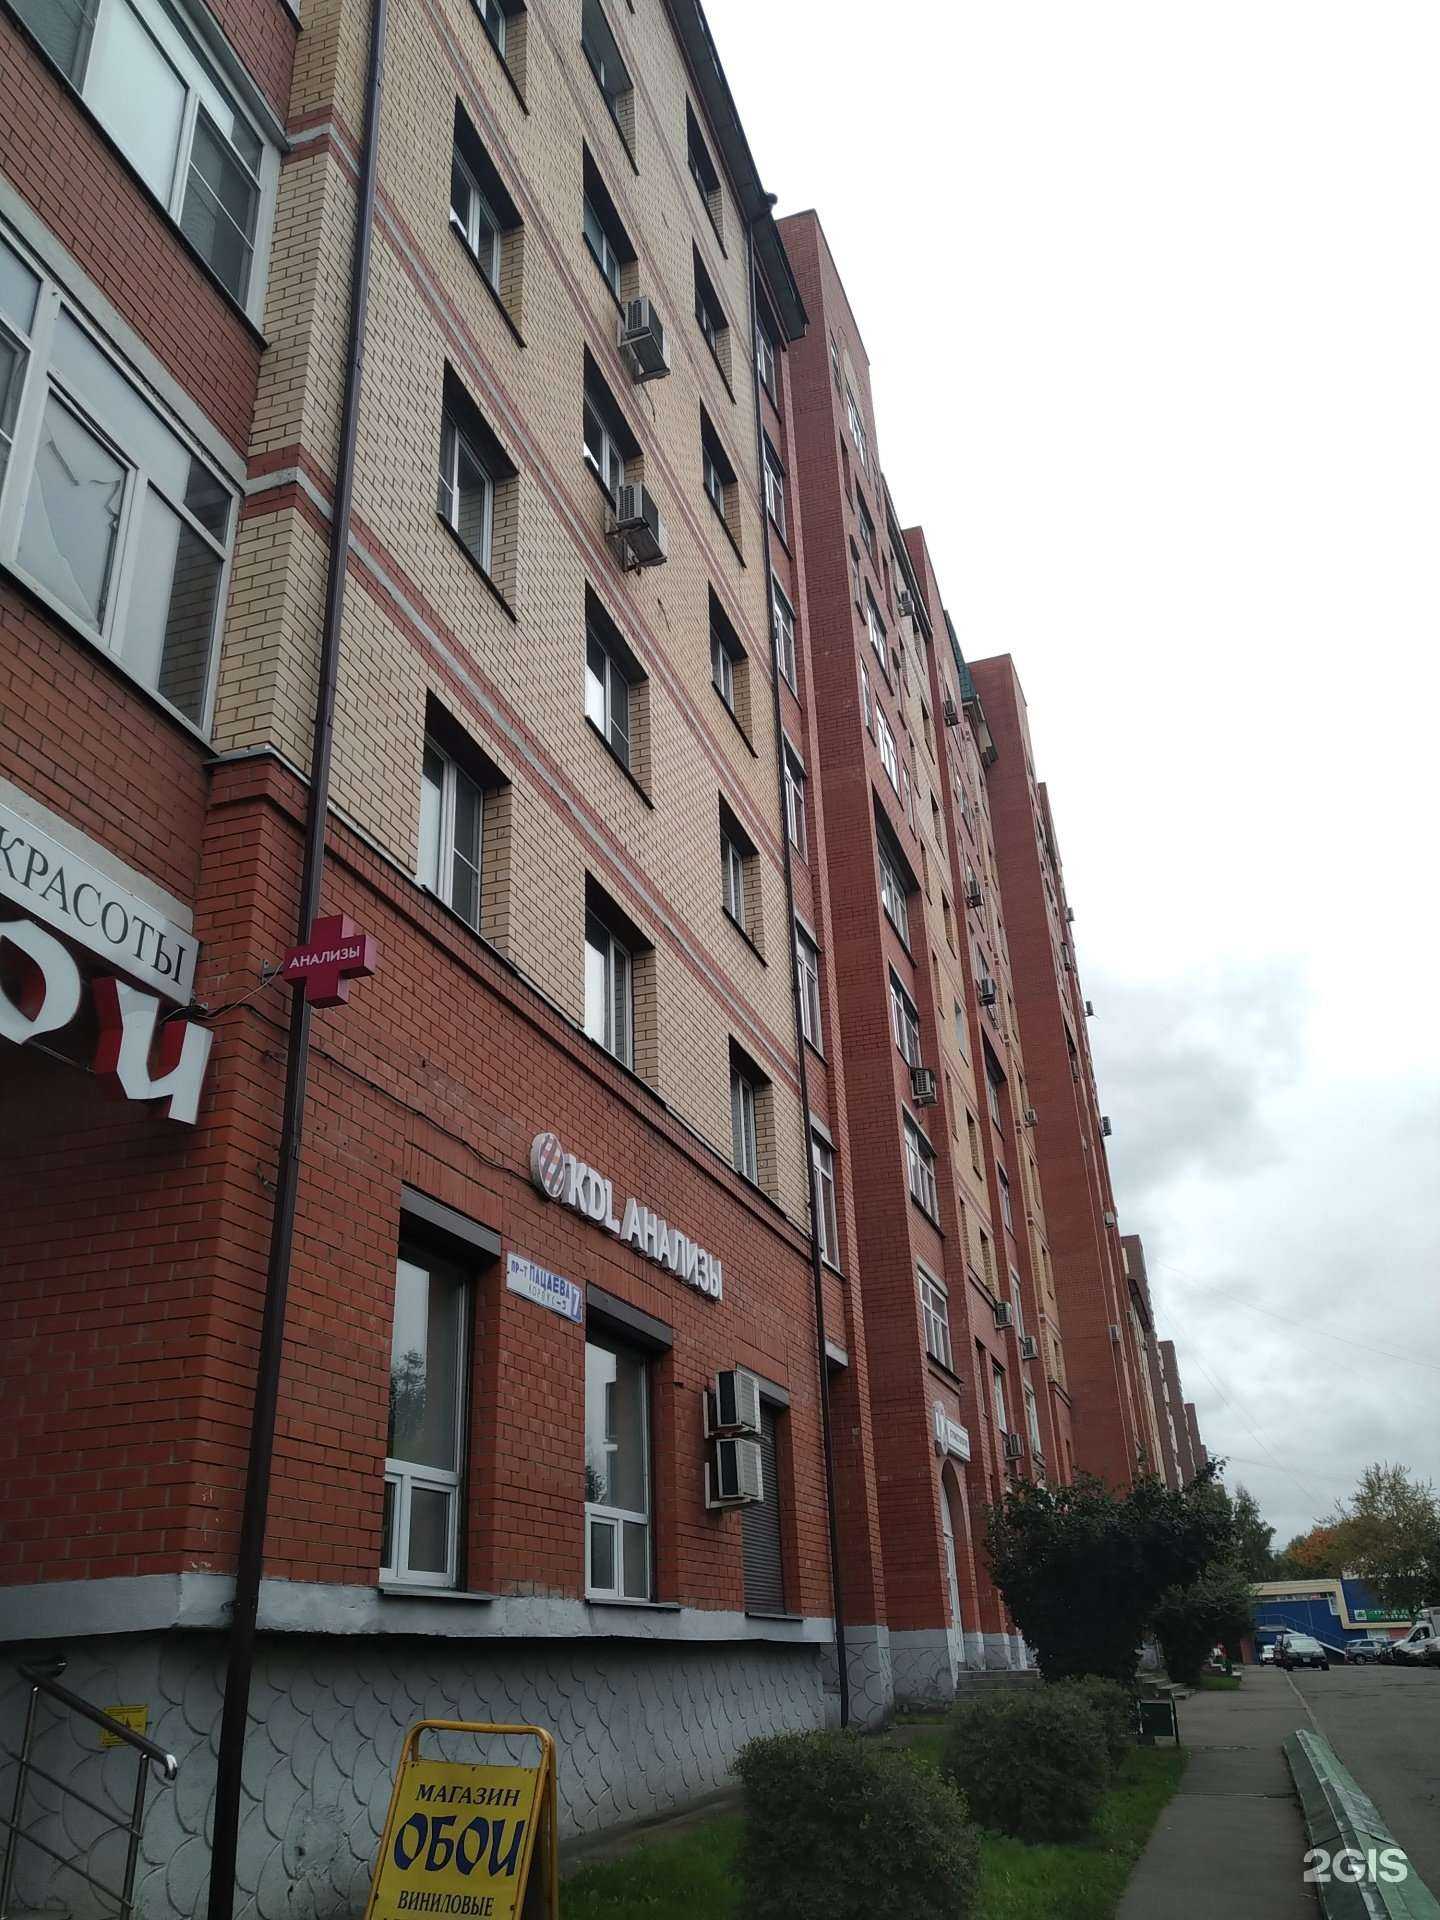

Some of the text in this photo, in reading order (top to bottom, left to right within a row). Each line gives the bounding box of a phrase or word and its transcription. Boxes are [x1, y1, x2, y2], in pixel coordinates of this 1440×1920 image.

[0, 824, 189, 986] КРАСОТЫ
[288, 945, 361, 969] АНАЛИЗЫ
[563, 1153, 621, 1234] KDL
[620, 1197, 723, 1302] АНАЛИЗЫ
[529, 1265, 570, 1300] ПАЦАЕВА
[416, 1783, 521, 1807] МАГАЗИН
[393, 1812, 527, 1878] ОБОИ
[397, 1890, 495, 1917] ВИНИЛОВЫЕ
